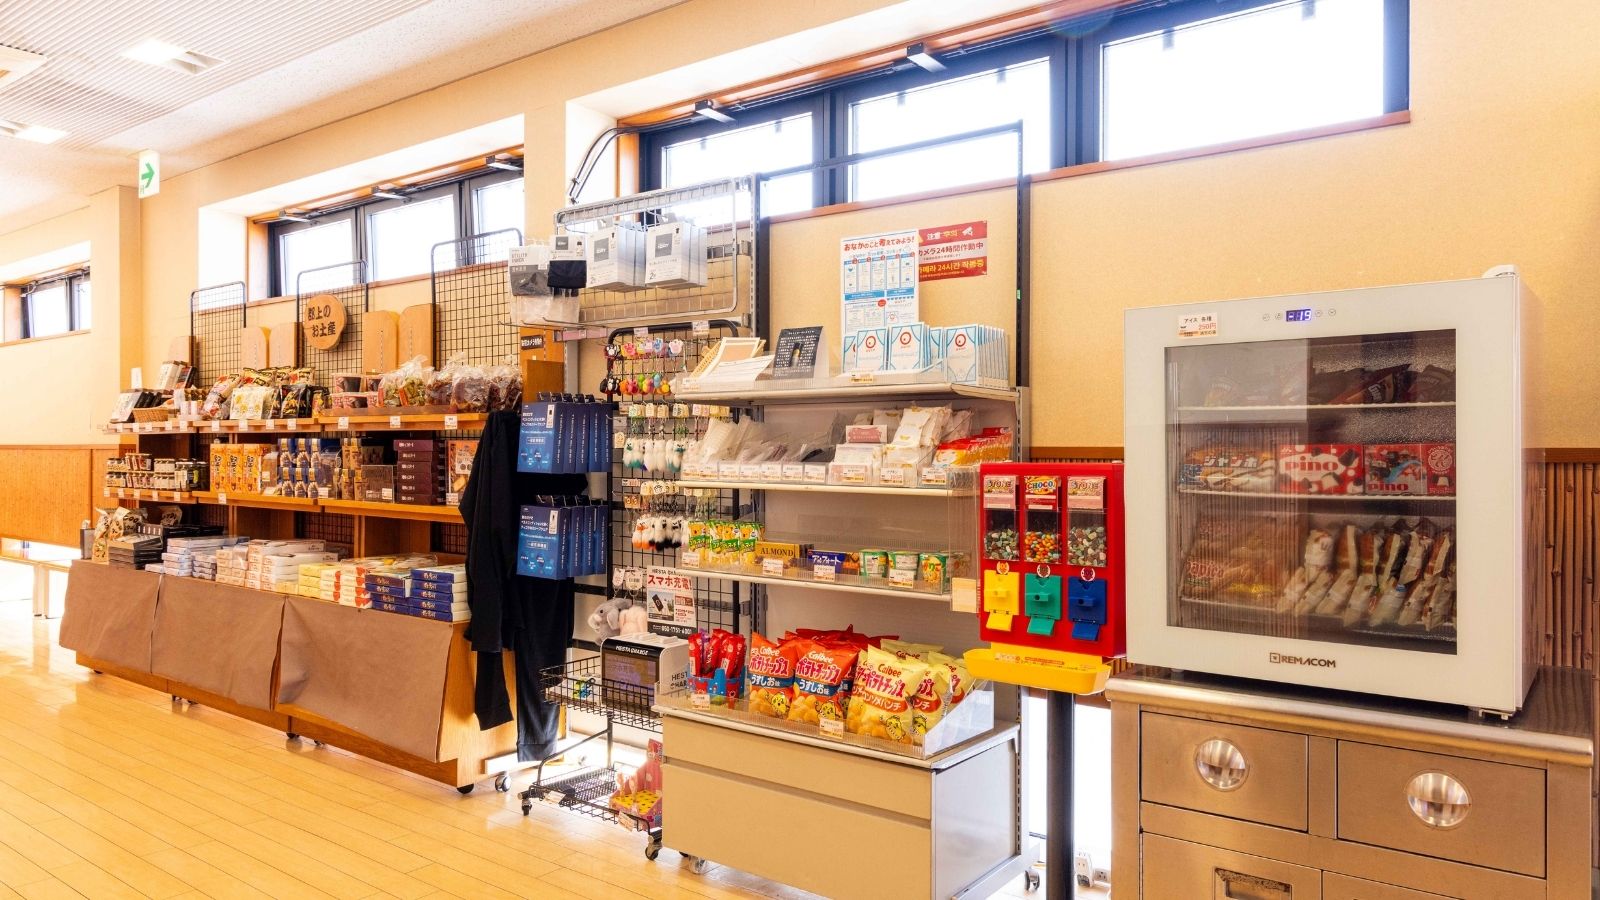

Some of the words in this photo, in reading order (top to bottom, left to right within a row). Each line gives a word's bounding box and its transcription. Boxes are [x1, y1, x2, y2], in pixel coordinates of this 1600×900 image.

[937, 262, 960, 271] 24시간
[308, 304, 331, 321] 郡上の
[1288, 310, 1311, 321] -19
[312, 321, 336, 338] お土産
[1284, 456, 1339, 471] pino
[1367, 481, 1409, 491] pino
[760, 547, 794, 557] ALMOND
[648, 574, 693, 591] スマホ充電!
[759, 646, 780, 657] Calbee
[808, 650, 834, 664] Calbee
[749, 655, 790, 677] ポテトチップス
[1281, 655, 1336, 668] REMACOM
[795, 657, 842, 686] ポテトチップス
[877, 663, 902, 678] Calbee
[751, 674, 780, 687] うすしお味
[799, 678, 830, 696] うすしお味
[864, 670, 906, 698] ポテトチップス
